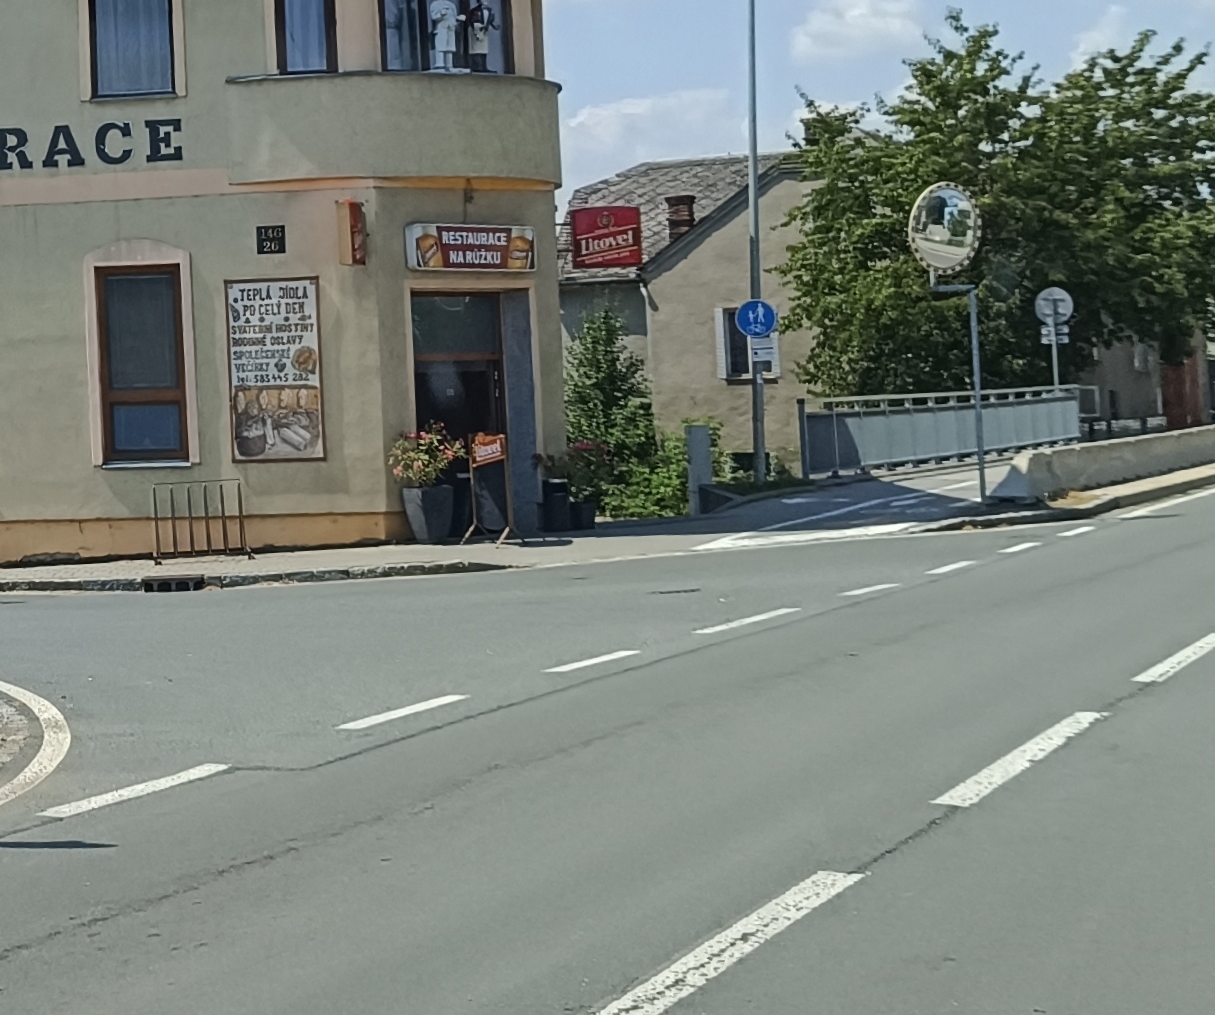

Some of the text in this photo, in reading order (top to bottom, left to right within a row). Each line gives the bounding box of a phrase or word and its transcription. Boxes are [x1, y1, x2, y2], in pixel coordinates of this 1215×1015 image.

[442, 231, 508, 245] RESTAURACE
[580, 230, 634, 255] Litovel
[449, 248, 501, 264] NA RŮŽKU
[239, 285, 308, 301] TEPLÁ JÍDLA
[242, 304, 256, 316] PO
[284, 302, 305, 314] DEN
